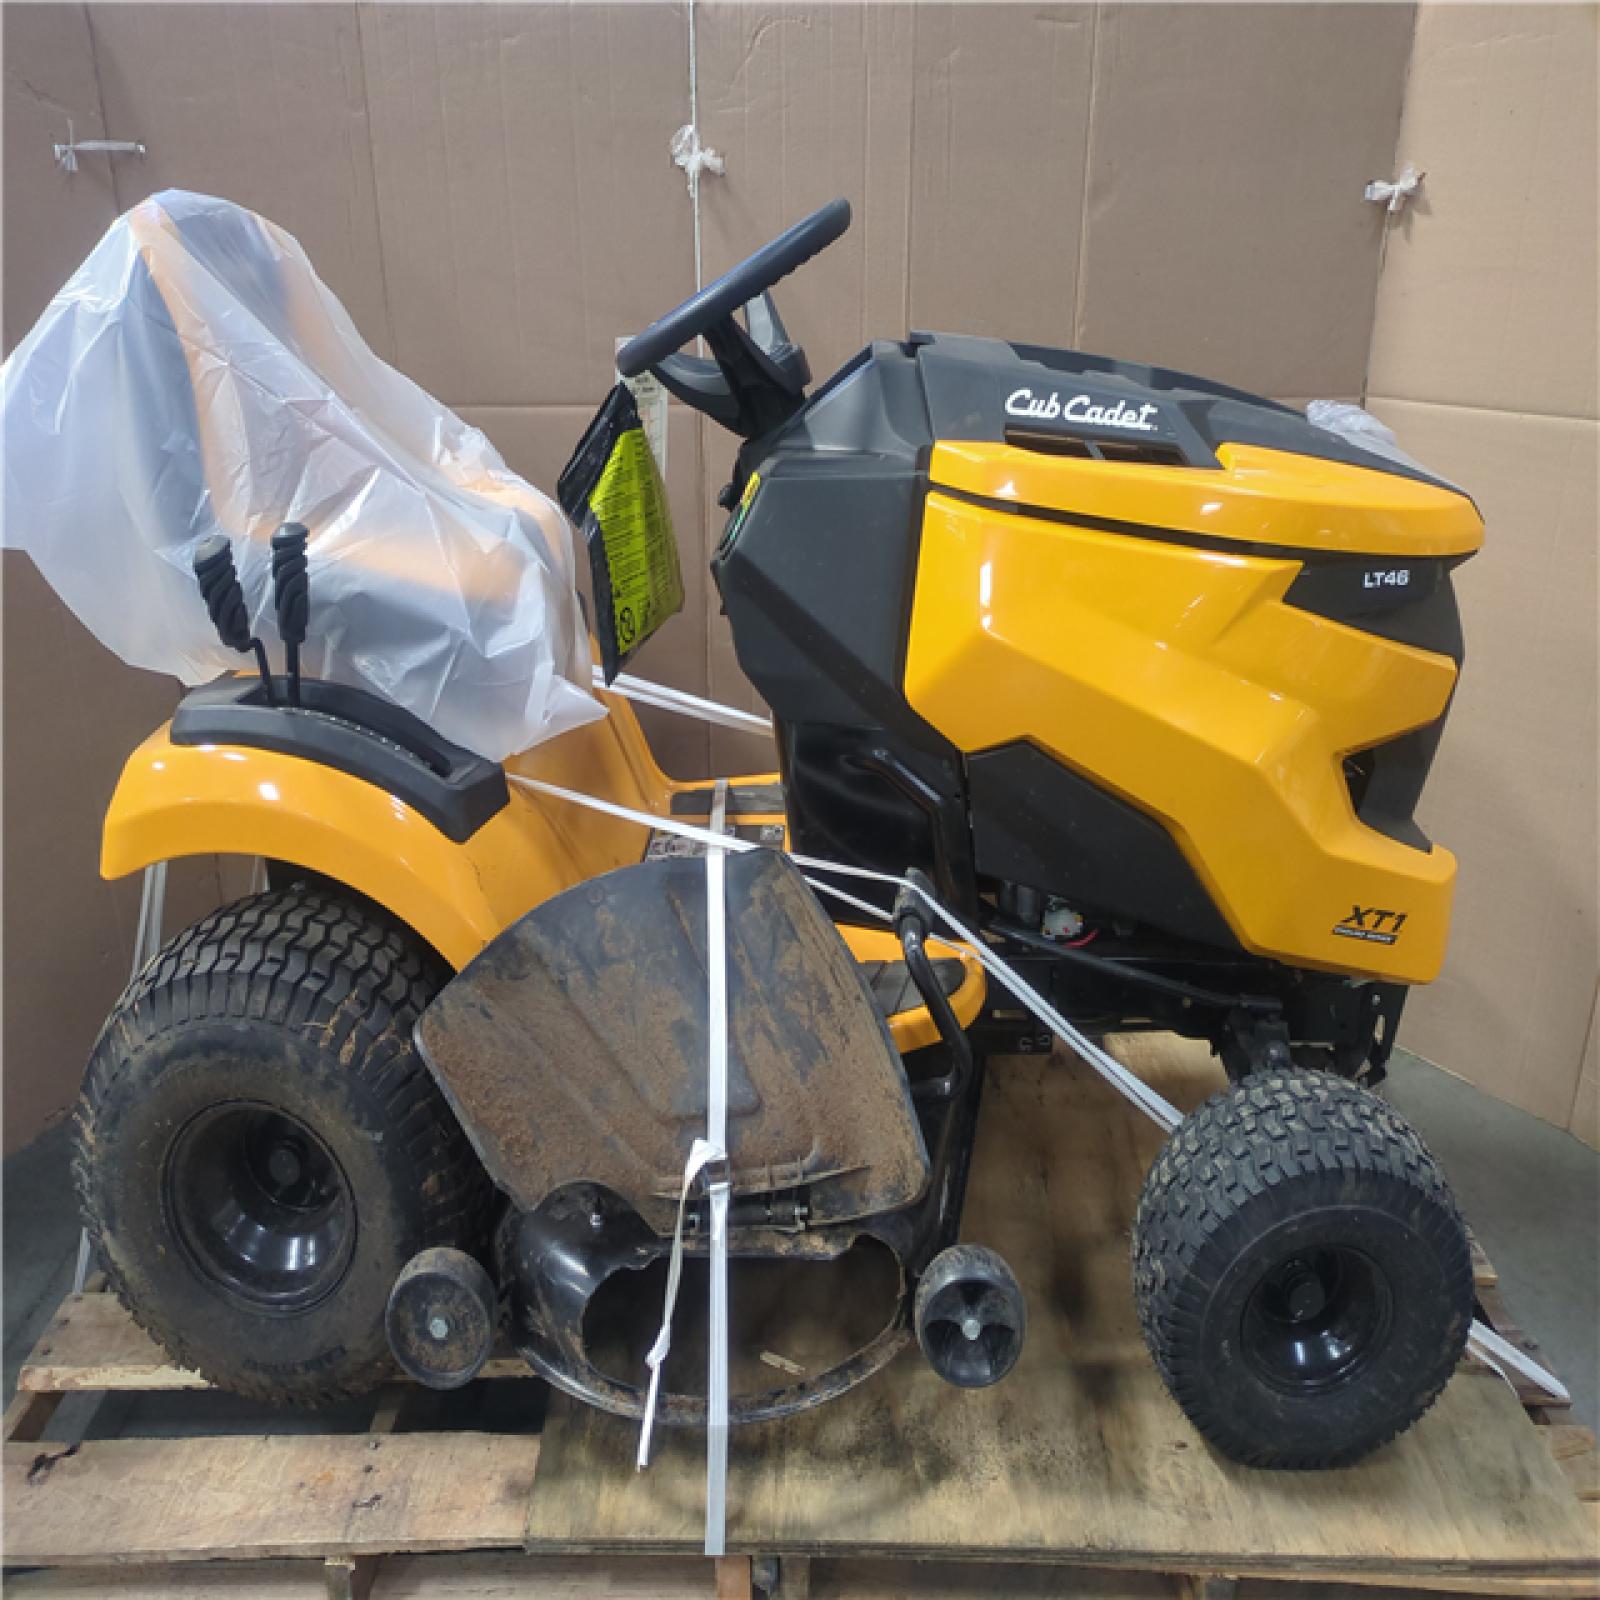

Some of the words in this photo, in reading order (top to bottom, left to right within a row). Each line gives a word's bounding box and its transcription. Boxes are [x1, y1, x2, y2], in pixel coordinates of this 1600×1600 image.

[1004, 388, 1061, 419] Cub
[1064, 394, 1158, 430] Cadet
[1341, 905, 1407, 932] XT1
